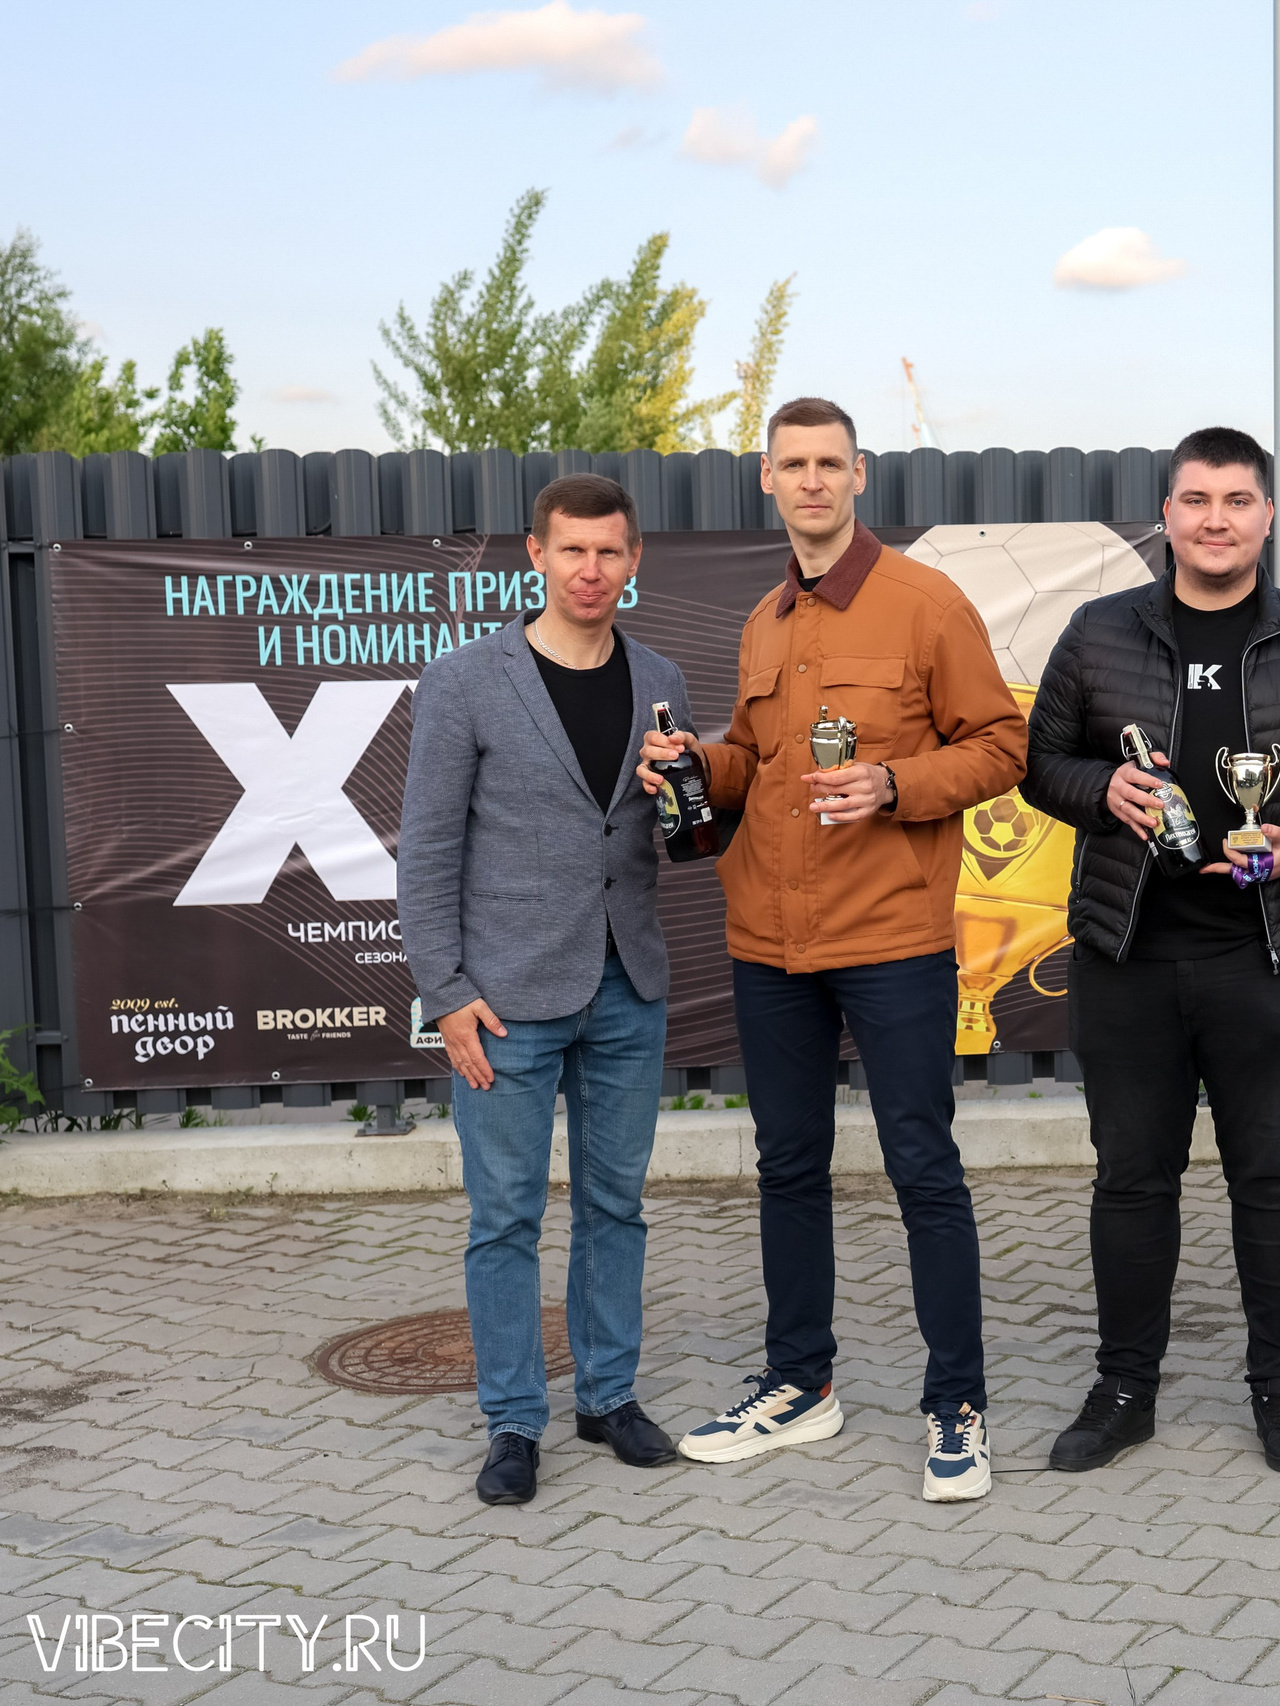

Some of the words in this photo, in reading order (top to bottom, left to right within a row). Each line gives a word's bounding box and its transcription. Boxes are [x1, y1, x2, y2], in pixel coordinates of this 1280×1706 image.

[165, 572, 436, 621] НАГРАЖДЕНИЕ
[448, 570, 639, 611] ПРИЗВ
[258, 625, 282, 666] И
[287, 920, 403, 943] ЧЕМПИО
[110, 998, 150, 1012] 2009
[154, 997, 179, 1010] est.
[257, 1006, 387, 1030] BROKKER
[287, 1033, 309, 1041] TASTE
[321, 1031, 351, 1039] FRIENDS
[416, 1036, 443, 1045] АФИ
